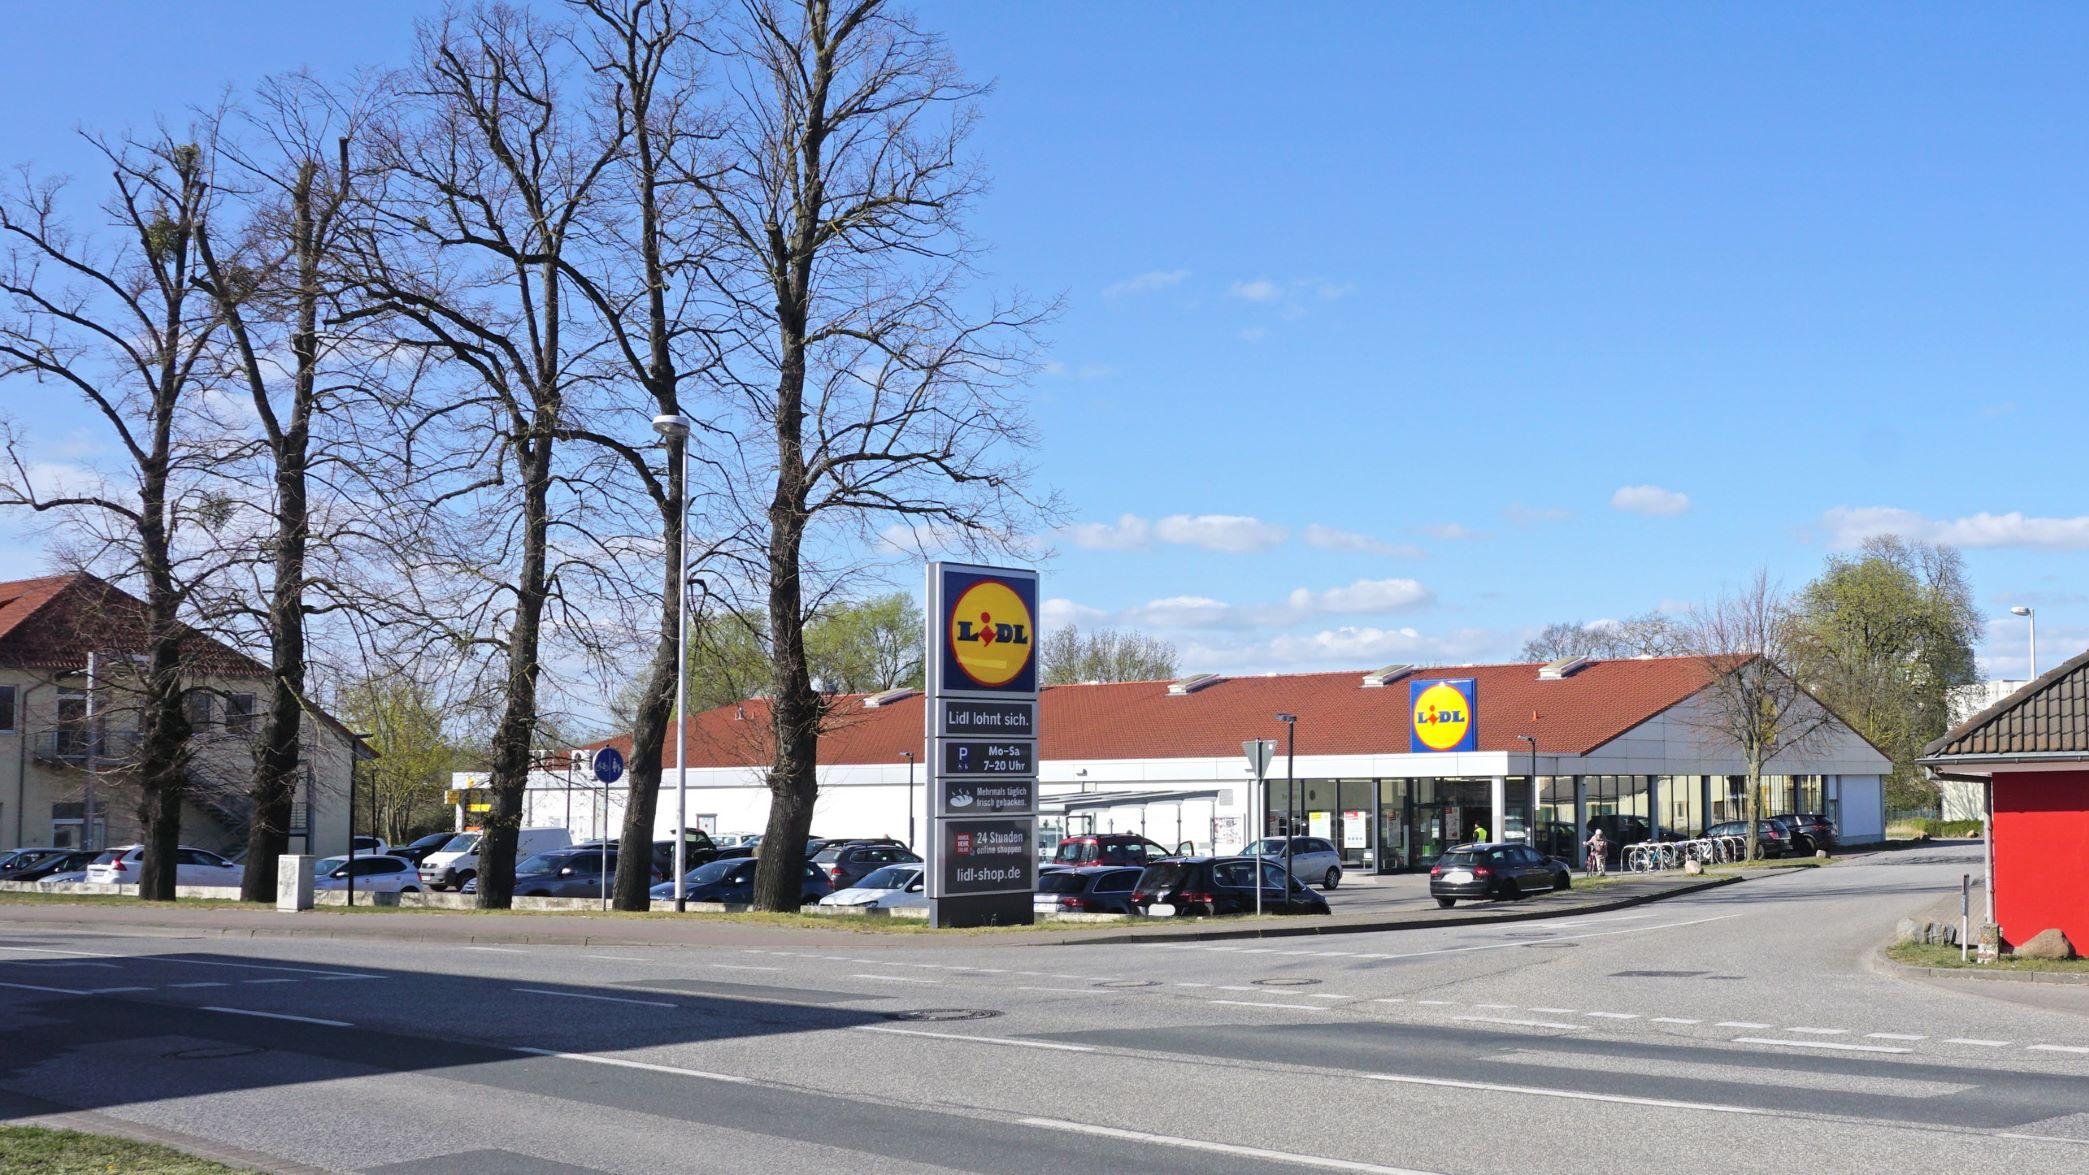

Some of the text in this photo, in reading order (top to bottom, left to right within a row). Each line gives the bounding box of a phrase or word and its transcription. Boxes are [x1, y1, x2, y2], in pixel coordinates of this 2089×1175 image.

[949, 711, 1029, 726] Lidl lohnt sich.
[959, 747, 968, 760] P
[988, 746, 1020, 756] Mo-Sa
[983, 760, 1026, 771] 7-20 Uhr
[976, 786, 1027, 797] Mehrmals täglich
[976, 798, 995, 807] frisch
[976, 832, 988, 844] 24
[989, 831, 1024, 844] Stunden
[976, 845, 1022, 855] online shoppen
[956, 866, 1021, 883] lidl-shop.de
